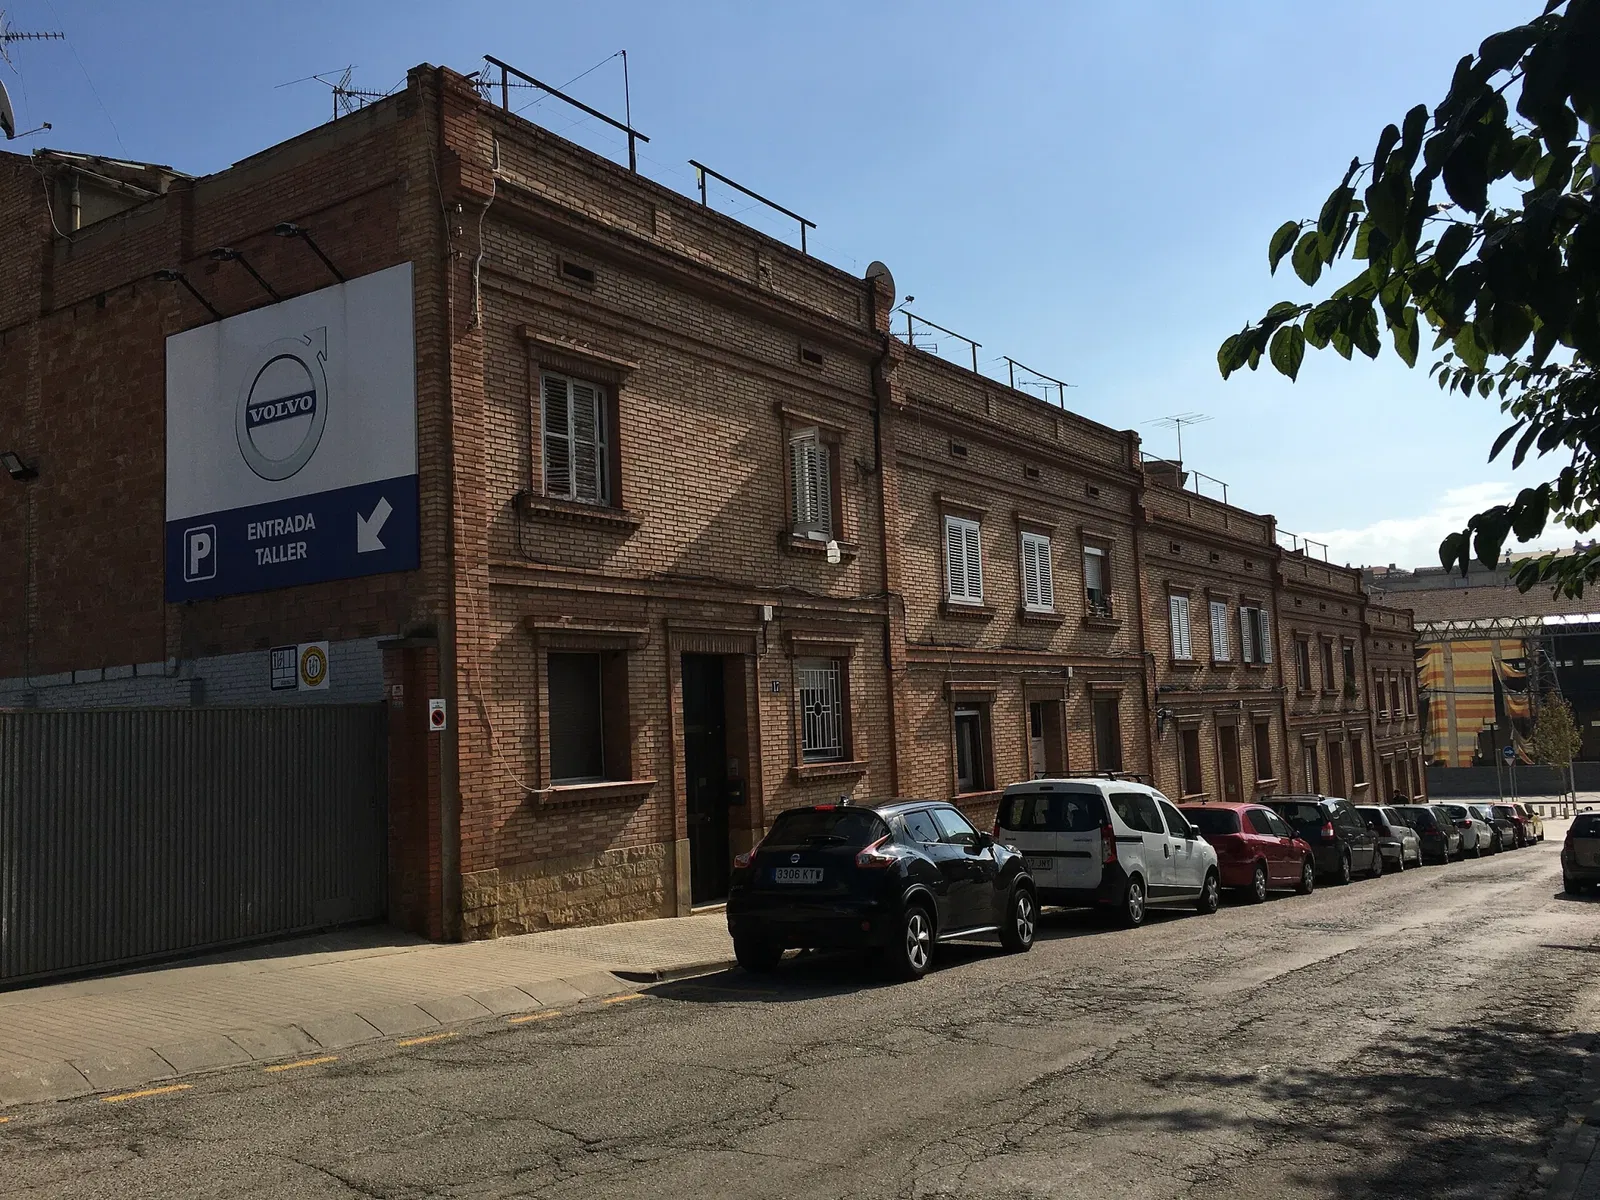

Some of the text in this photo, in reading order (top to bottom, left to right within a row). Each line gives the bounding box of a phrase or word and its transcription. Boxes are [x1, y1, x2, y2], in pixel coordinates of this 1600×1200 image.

[249, 395, 313, 422] VOLVO
[247, 512, 316, 541] ENTRADA
[190, 532, 211, 575] P
[255, 541, 307, 566] TALLER
[777, 869, 800, 879] 3306
